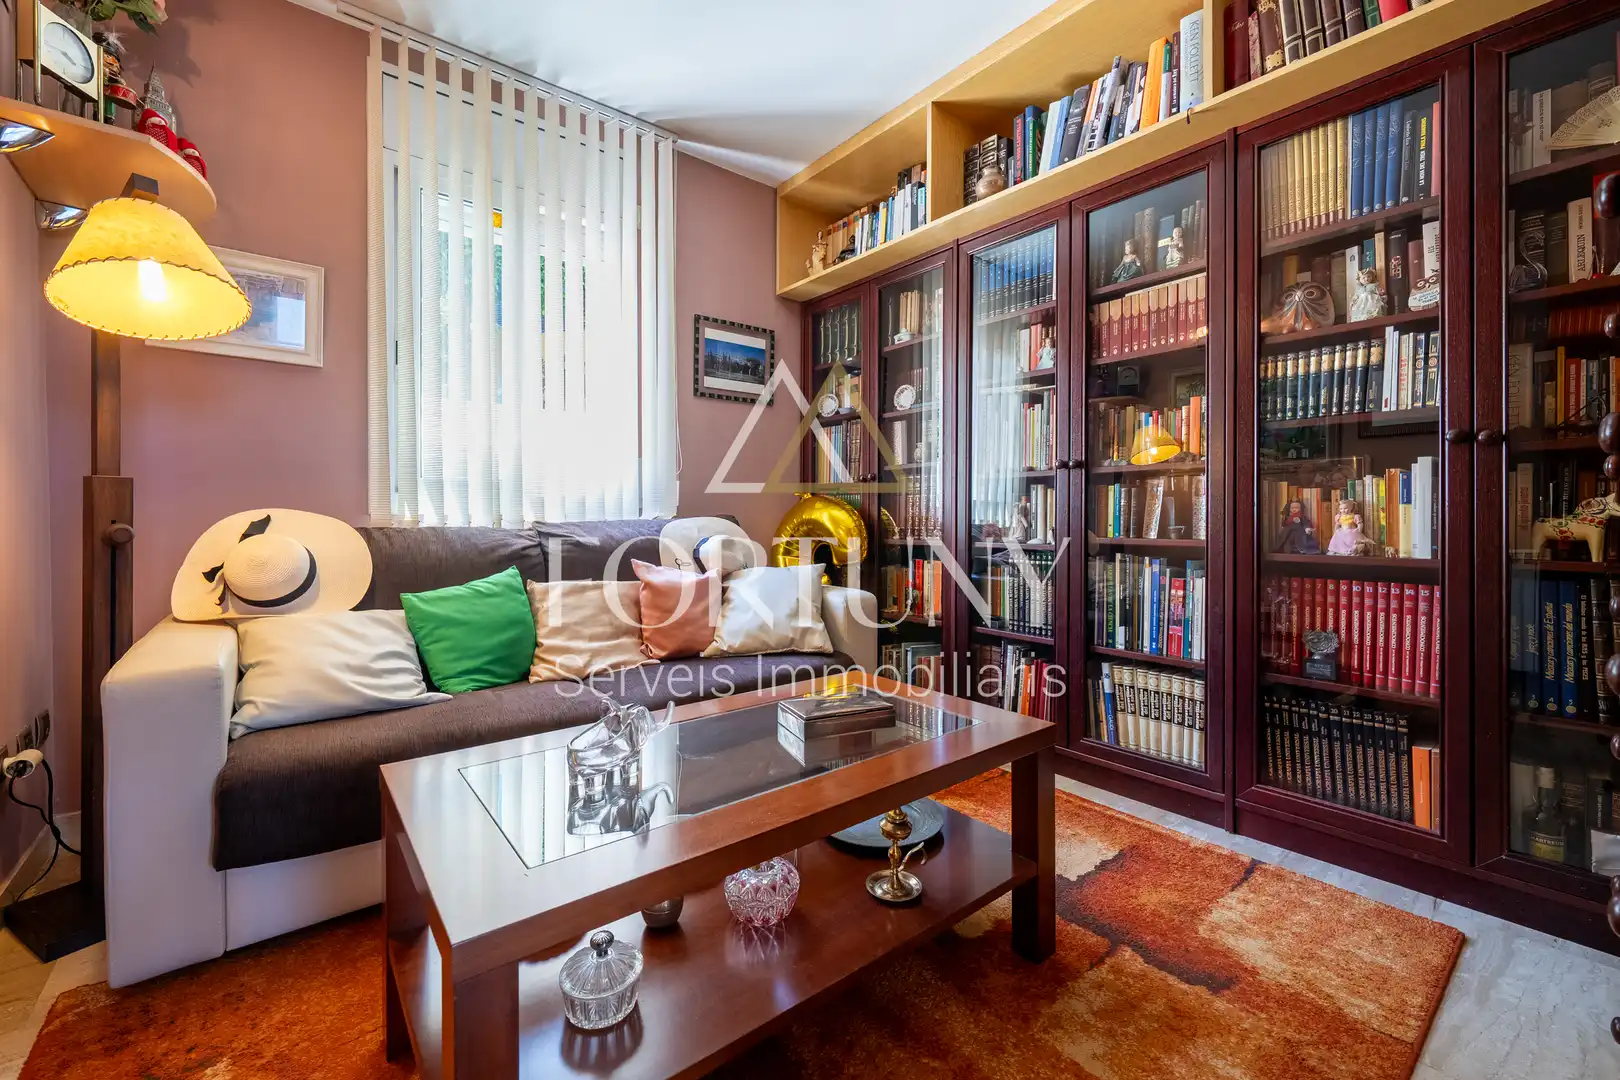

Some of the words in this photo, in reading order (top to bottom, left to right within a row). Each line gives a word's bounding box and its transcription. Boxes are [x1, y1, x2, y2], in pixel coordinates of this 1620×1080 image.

[1189, 20, 1200, 42] KEN
[1190, 43, 1200, 83] FOLLETT
[1576, 234, 1586, 272] ARLEQUIN
[1544, 661, 1555, 681] Música
[1400, 754, 1410, 787] UNIVERSAL
